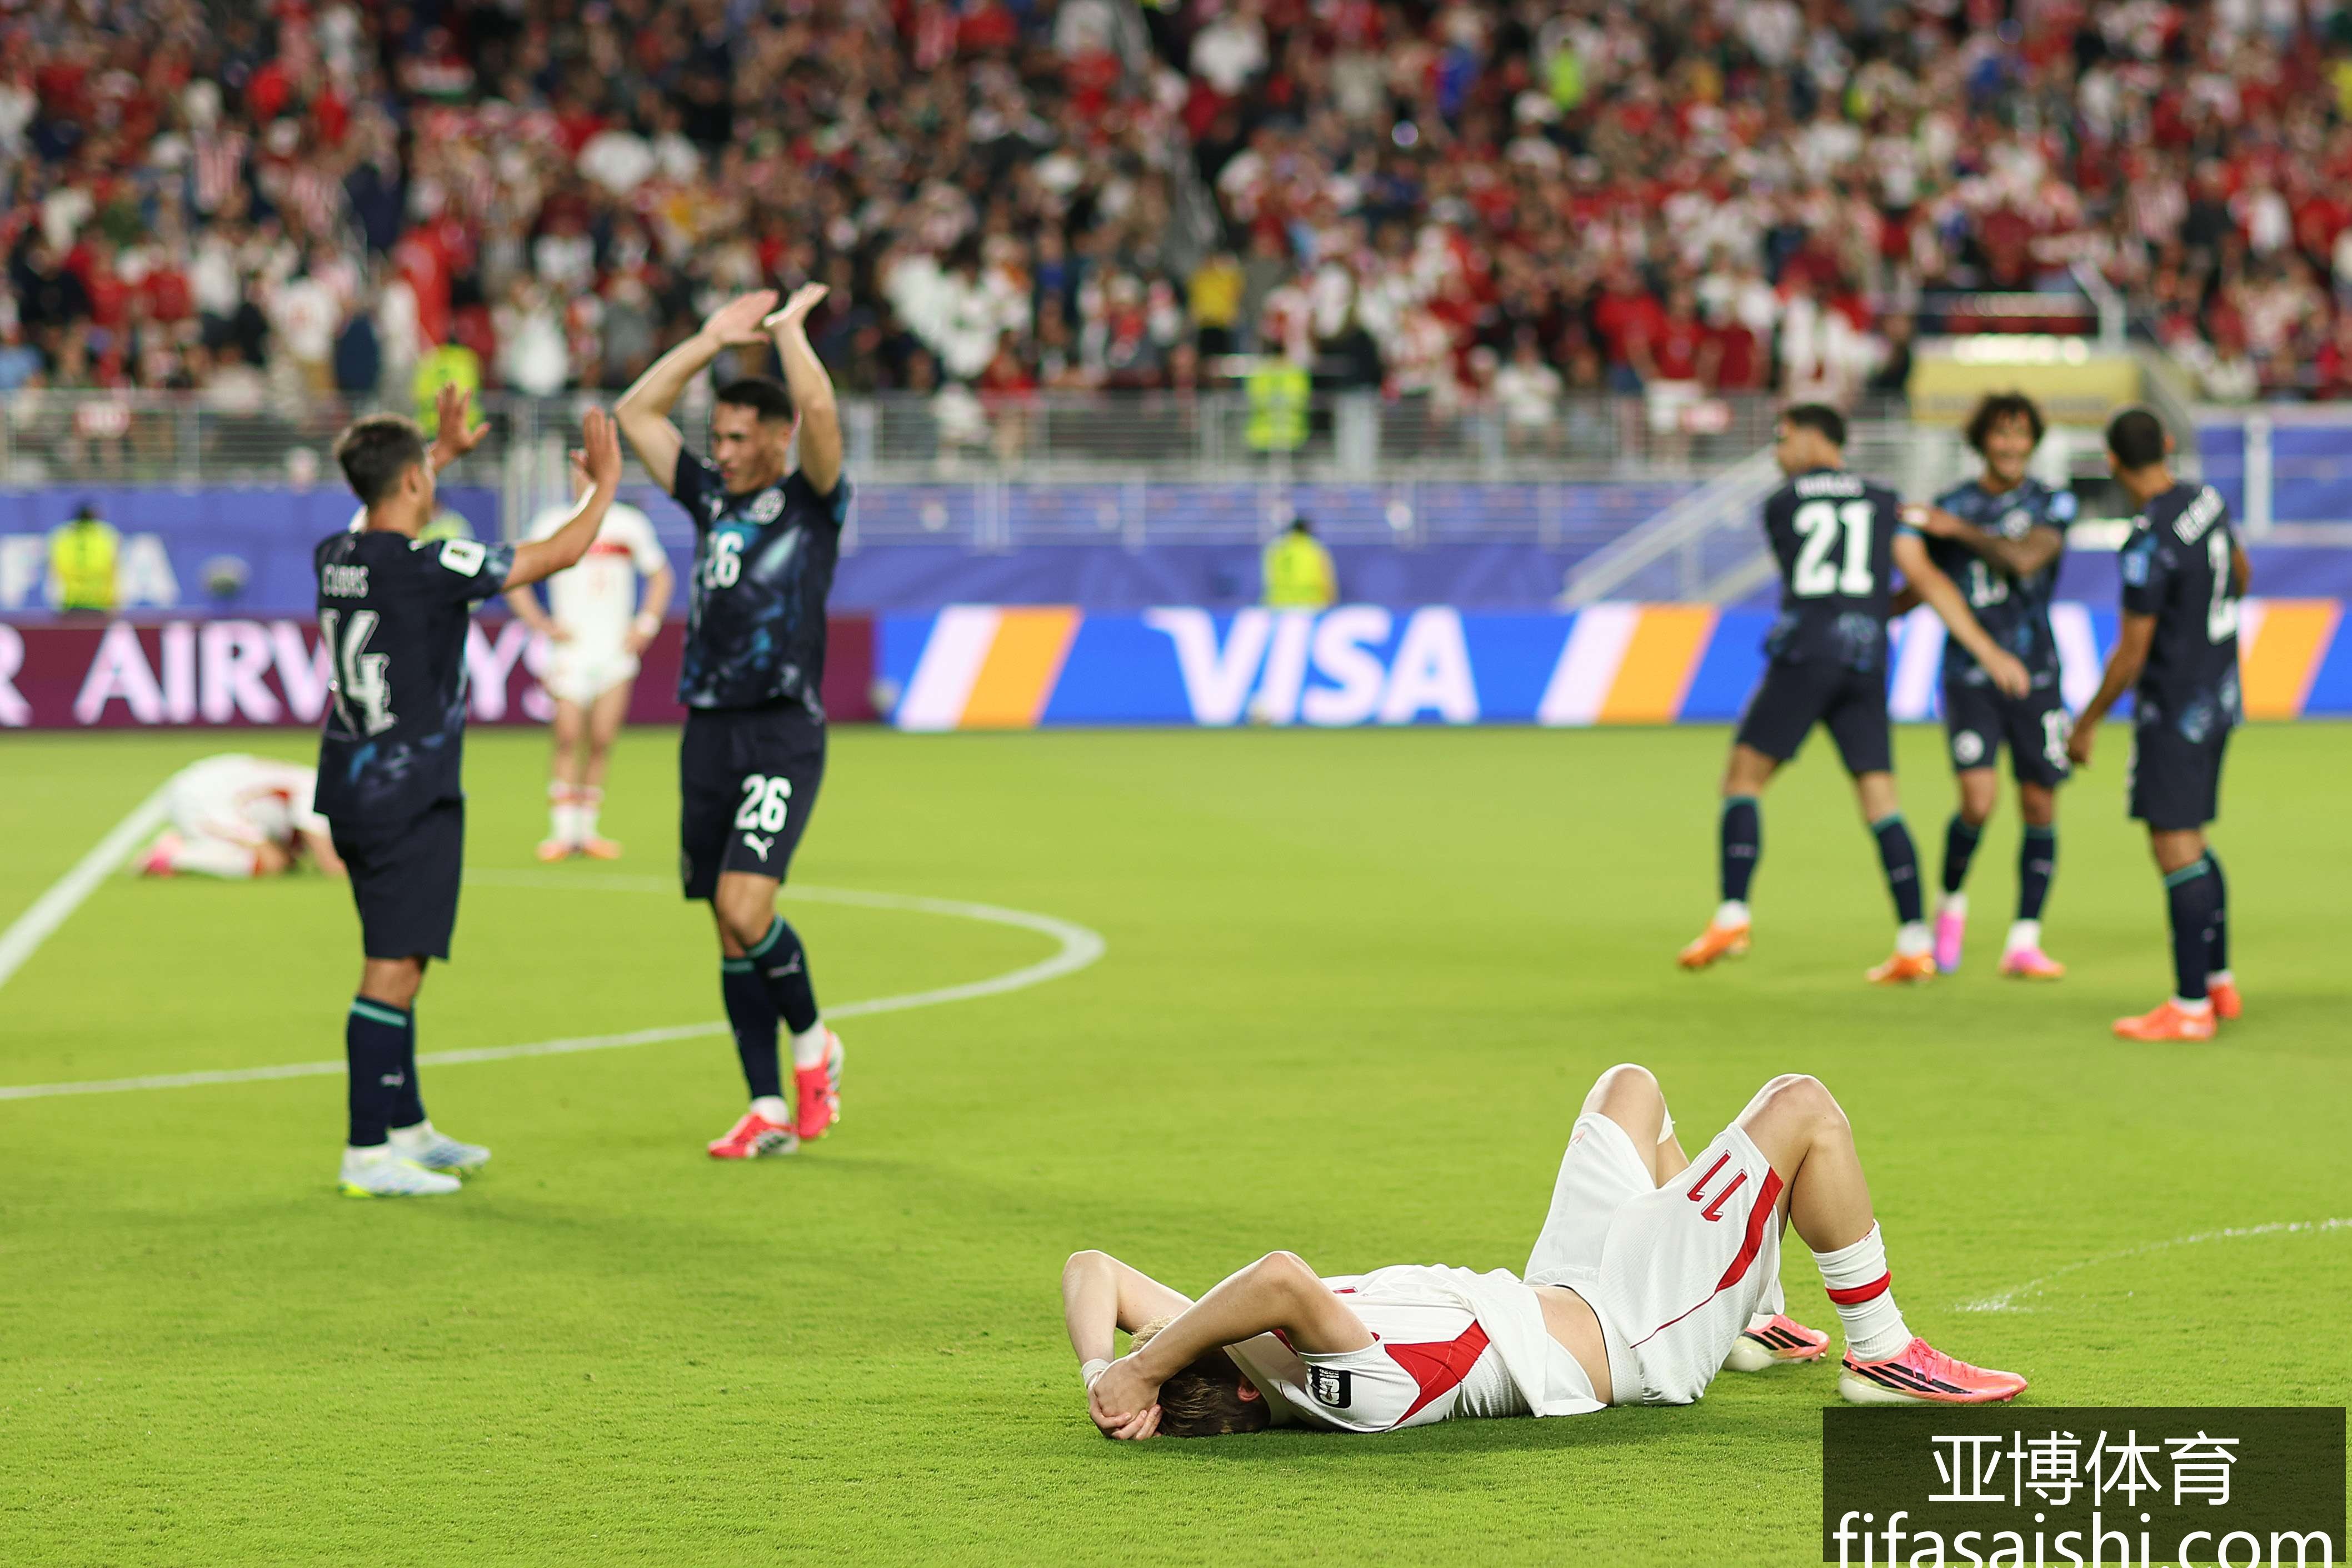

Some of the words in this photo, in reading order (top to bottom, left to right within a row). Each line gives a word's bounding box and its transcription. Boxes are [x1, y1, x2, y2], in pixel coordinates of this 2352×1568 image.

[1792, 500, 1876, 598] 21
[74, 618, 556, 723] AIRWYS
[1142, 605, 1481, 726] VISA
[735, 773, 792, 833] 26
[1687, 1148, 1748, 1222] 11
